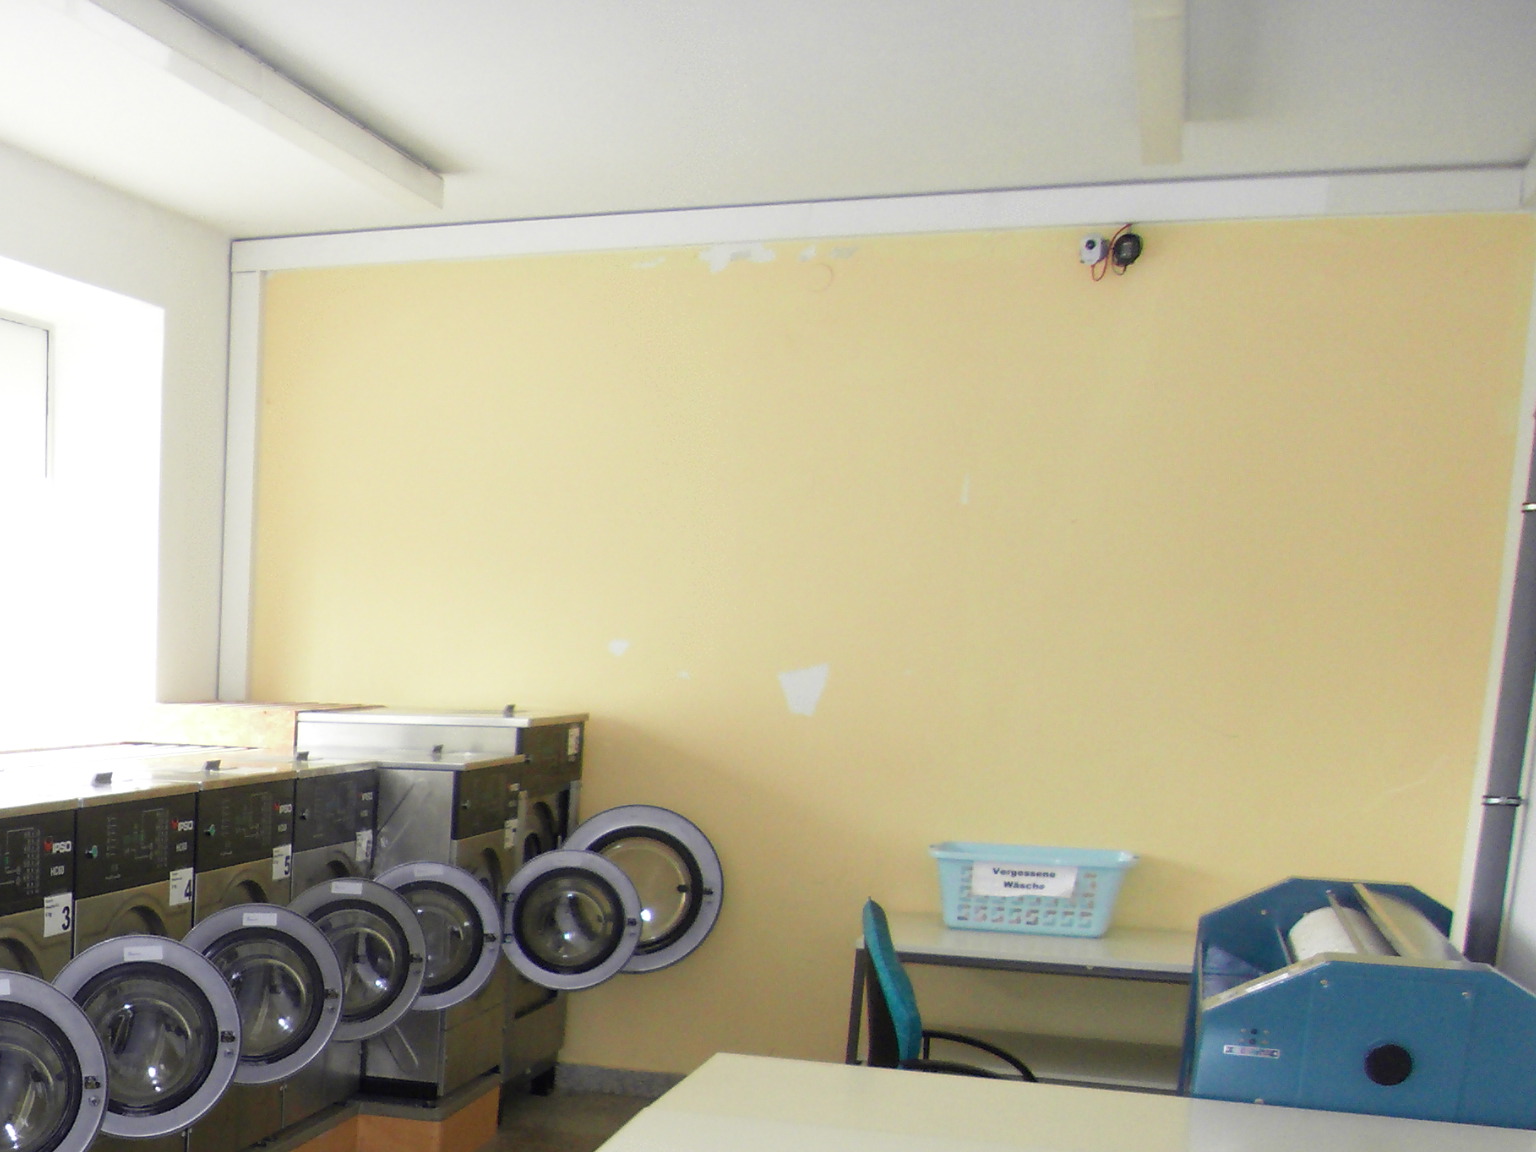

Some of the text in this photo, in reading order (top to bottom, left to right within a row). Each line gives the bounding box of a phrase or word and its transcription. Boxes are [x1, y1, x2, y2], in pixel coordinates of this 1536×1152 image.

[284, 856, 290, 876] 5
[993, 867, 1056, 878] Vergessene
[184, 879, 192, 901] 4
[1004, 881, 1045, 890] Wäsche
[61, 906, 70, 931] 3
